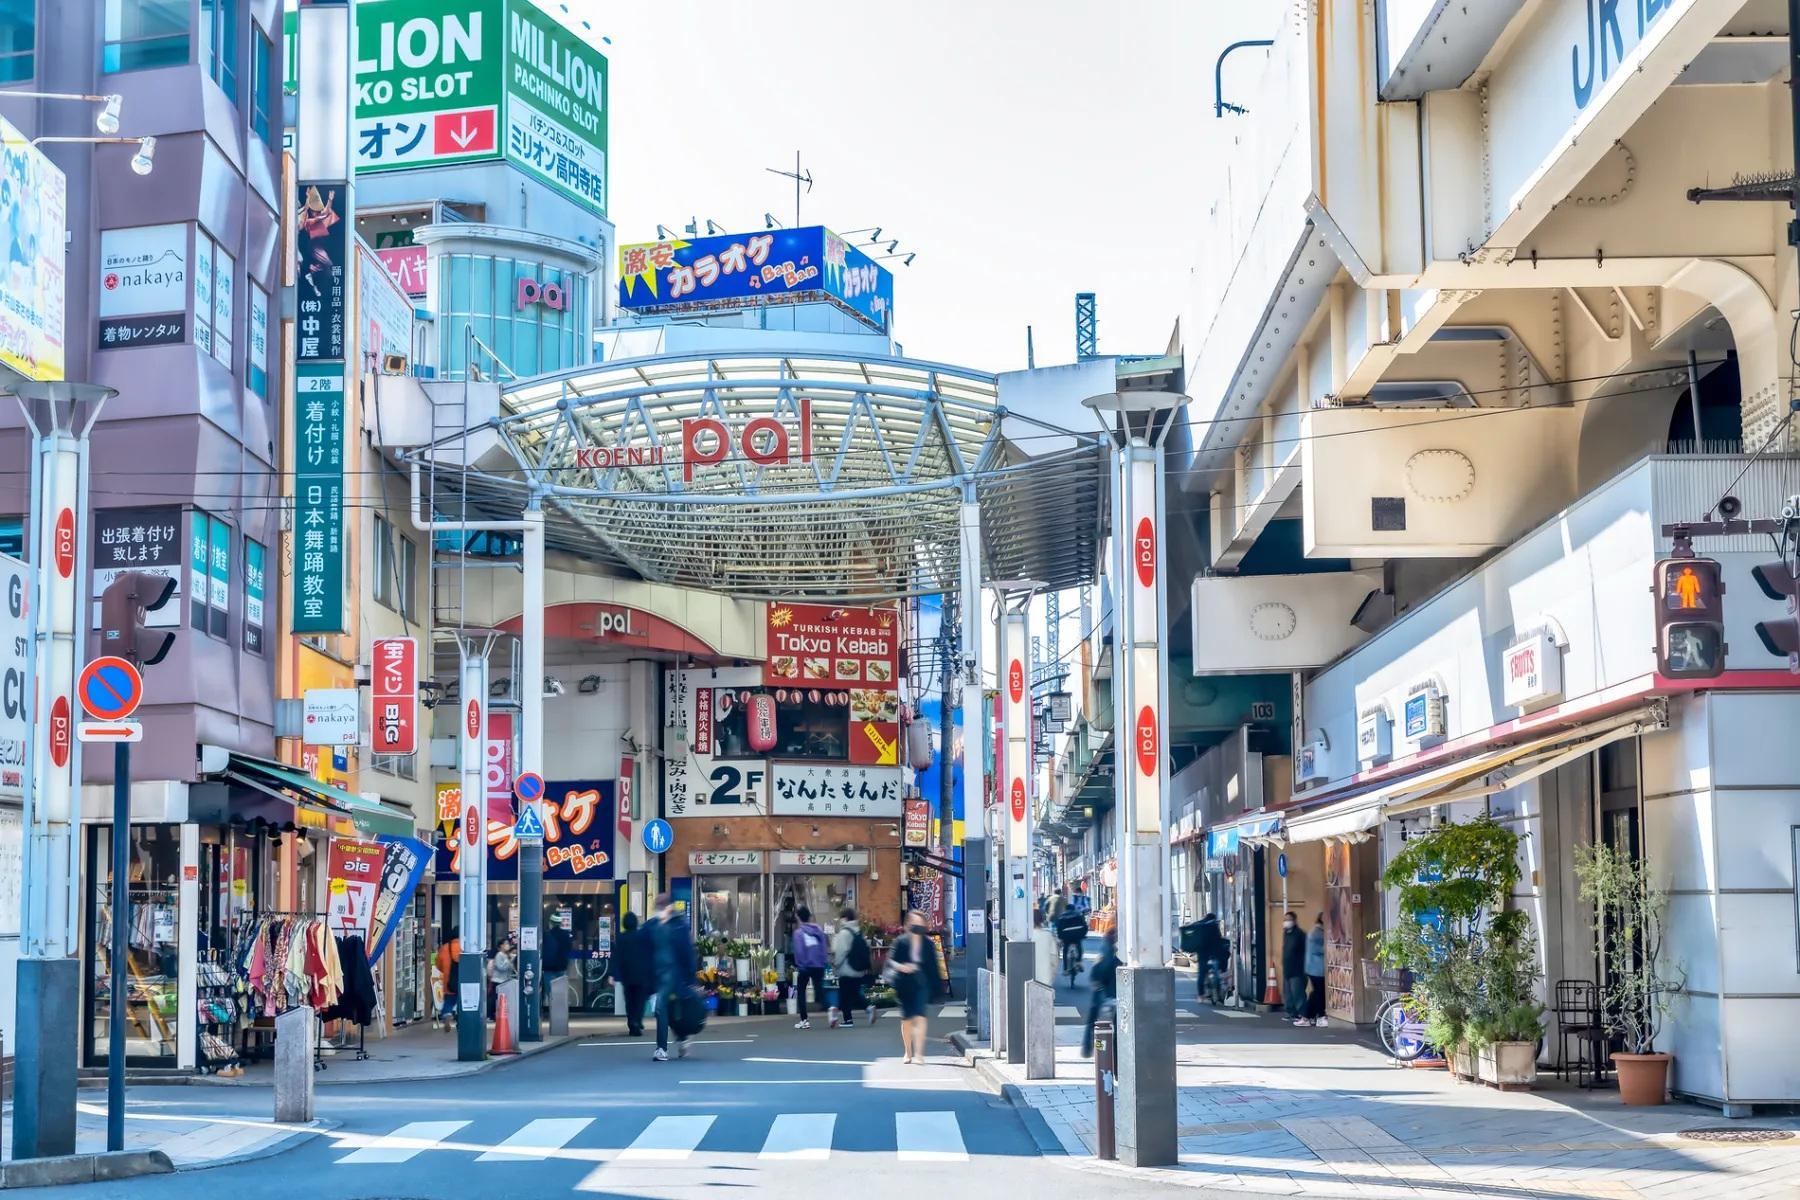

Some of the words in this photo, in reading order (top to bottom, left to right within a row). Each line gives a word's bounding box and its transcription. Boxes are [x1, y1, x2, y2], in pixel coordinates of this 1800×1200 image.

[356, 11, 482, 75] LION
[511, 10, 602, 112] MILLION
[401, 71, 473, 101] SLOT
[514, 63, 570, 117] PACHINKO
[573, 104, 599, 136] SLOT
[359, 121, 427, 159] オン
[529, 113, 586, 160] パチンコ&スロット
[511, 123, 602, 204] ミリオン高円寺店
[623, 242, 675, 276] 激安
[667, 234, 774, 298] カラオケ
[122, 269, 183, 288] nakaya
[761, 261, 795, 283] Ban
[784, 265, 819, 289] Ban
[842, 263, 879, 299] カラオケ
[517, 277, 571, 313] pal
[103, 324, 181, 342] 着物レンタル
[310, 379, 332, 391] 2階
[304, 401, 326, 466] 着付け
[576, 446, 665, 469] KOENJI
[682, 398, 813, 484] pal
[58, 528, 73, 559] pal
[101, 525, 176, 545] 出張着付け
[112, 544, 164, 561] 致します
[303, 485, 325, 619] 日本舞踊教室
[1138, 538, 1154, 568] pal
[600, 609, 631, 637] pal
[793, 624, 838, 635] TURKISH
[843, 627, 876, 636] KEBAB
[777, 633, 831, 654] Tokyo
[837, 636, 889, 656] Kebab
[383, 642, 405, 694] 宝くじ
[1011, 672, 1022, 691] pal
[317, 713, 355, 724] nakaya
[469, 710, 478, 729] pal
[697, 690, 710, 752] 本格炭火串焼
[1252, 705, 1273, 718] 103
[53, 717, 68, 747] pal
[384, 703, 400, 745] BIG
[343, 732, 356, 742] pal
[1139, 727, 1157, 757] pal
[807, 768, 867, 778] 大衆酒場
[619, 777, 632, 823] pal
[776, 777, 899, 801] なんたもんだ
[1012, 790, 1024, 810] pal
[807, 803, 866, 813] 高円寺店
[906, 812, 928, 821] Tokyo
[468, 817, 478, 835] pal
[906, 821, 927, 829] Kebab
[547, 843, 584, 867] Ban
[571, 851, 610, 874] Ban
[694, 852, 757, 866] 花ゼフィール
[797, 852, 852, 866] 花ゼフィール
